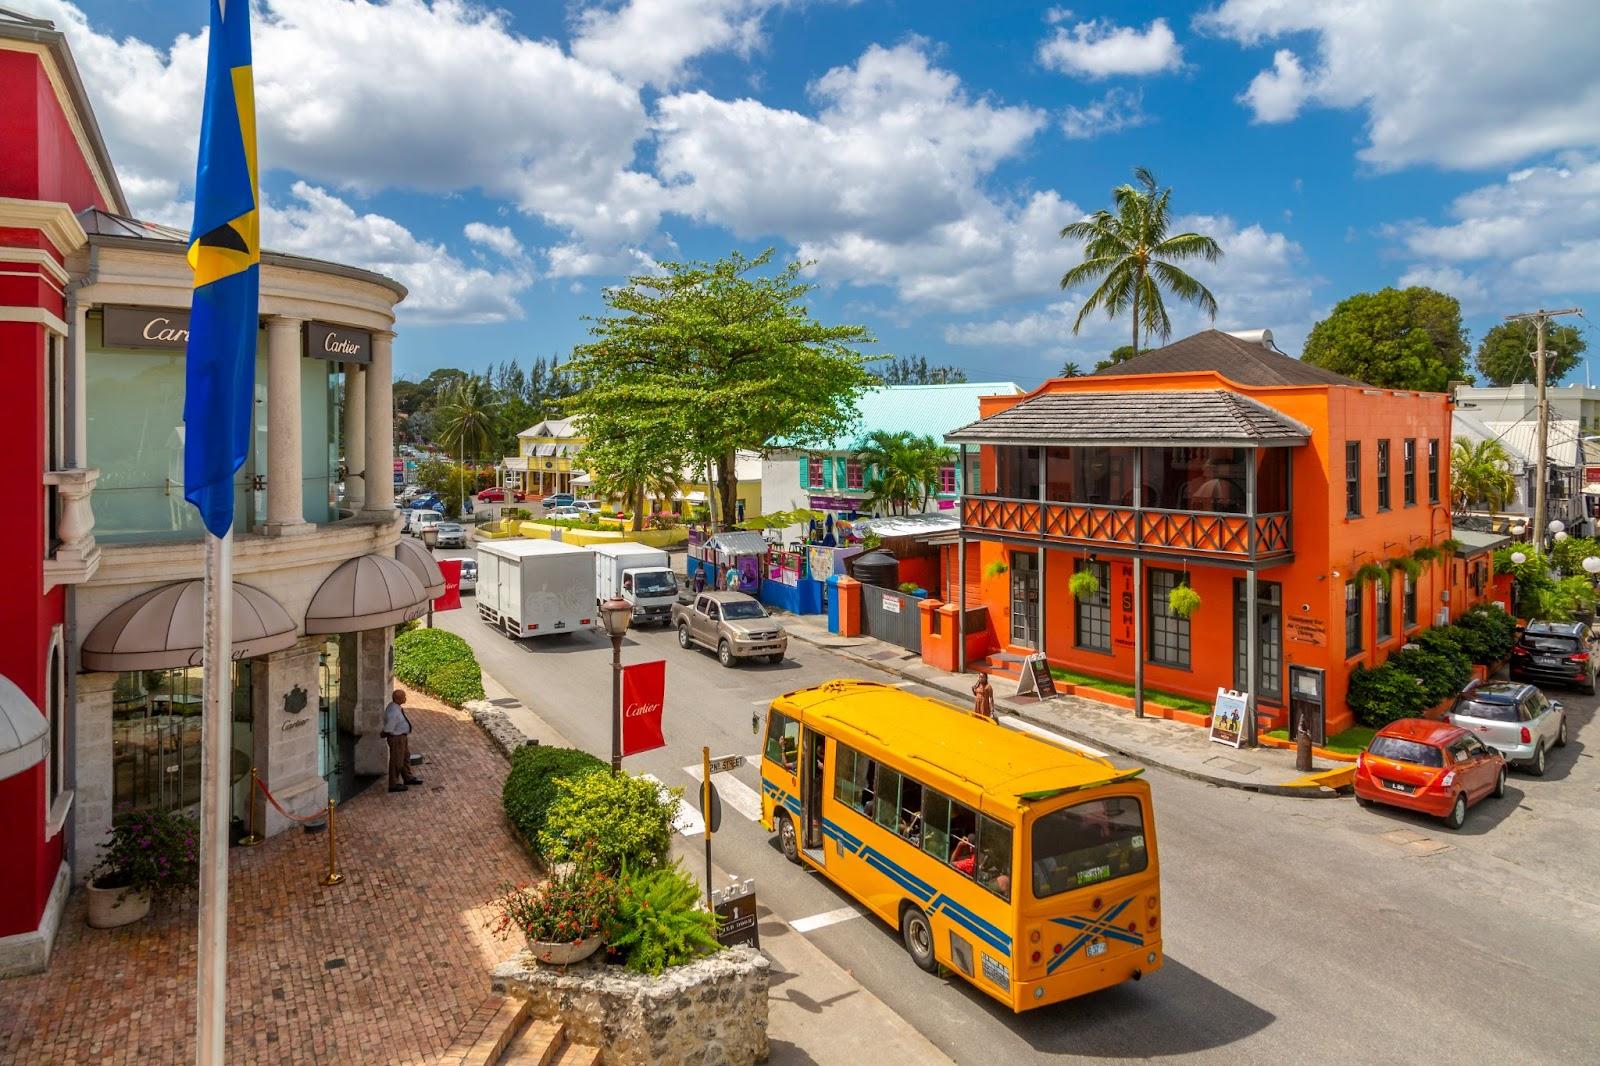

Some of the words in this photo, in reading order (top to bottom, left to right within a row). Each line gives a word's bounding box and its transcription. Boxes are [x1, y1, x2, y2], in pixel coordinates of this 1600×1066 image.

[324, 332, 360, 355] Cartier
[626, 702, 660, 718] Cartier
[281, 718, 310, 731] Cartier
[722, 756, 743, 770] STREET
